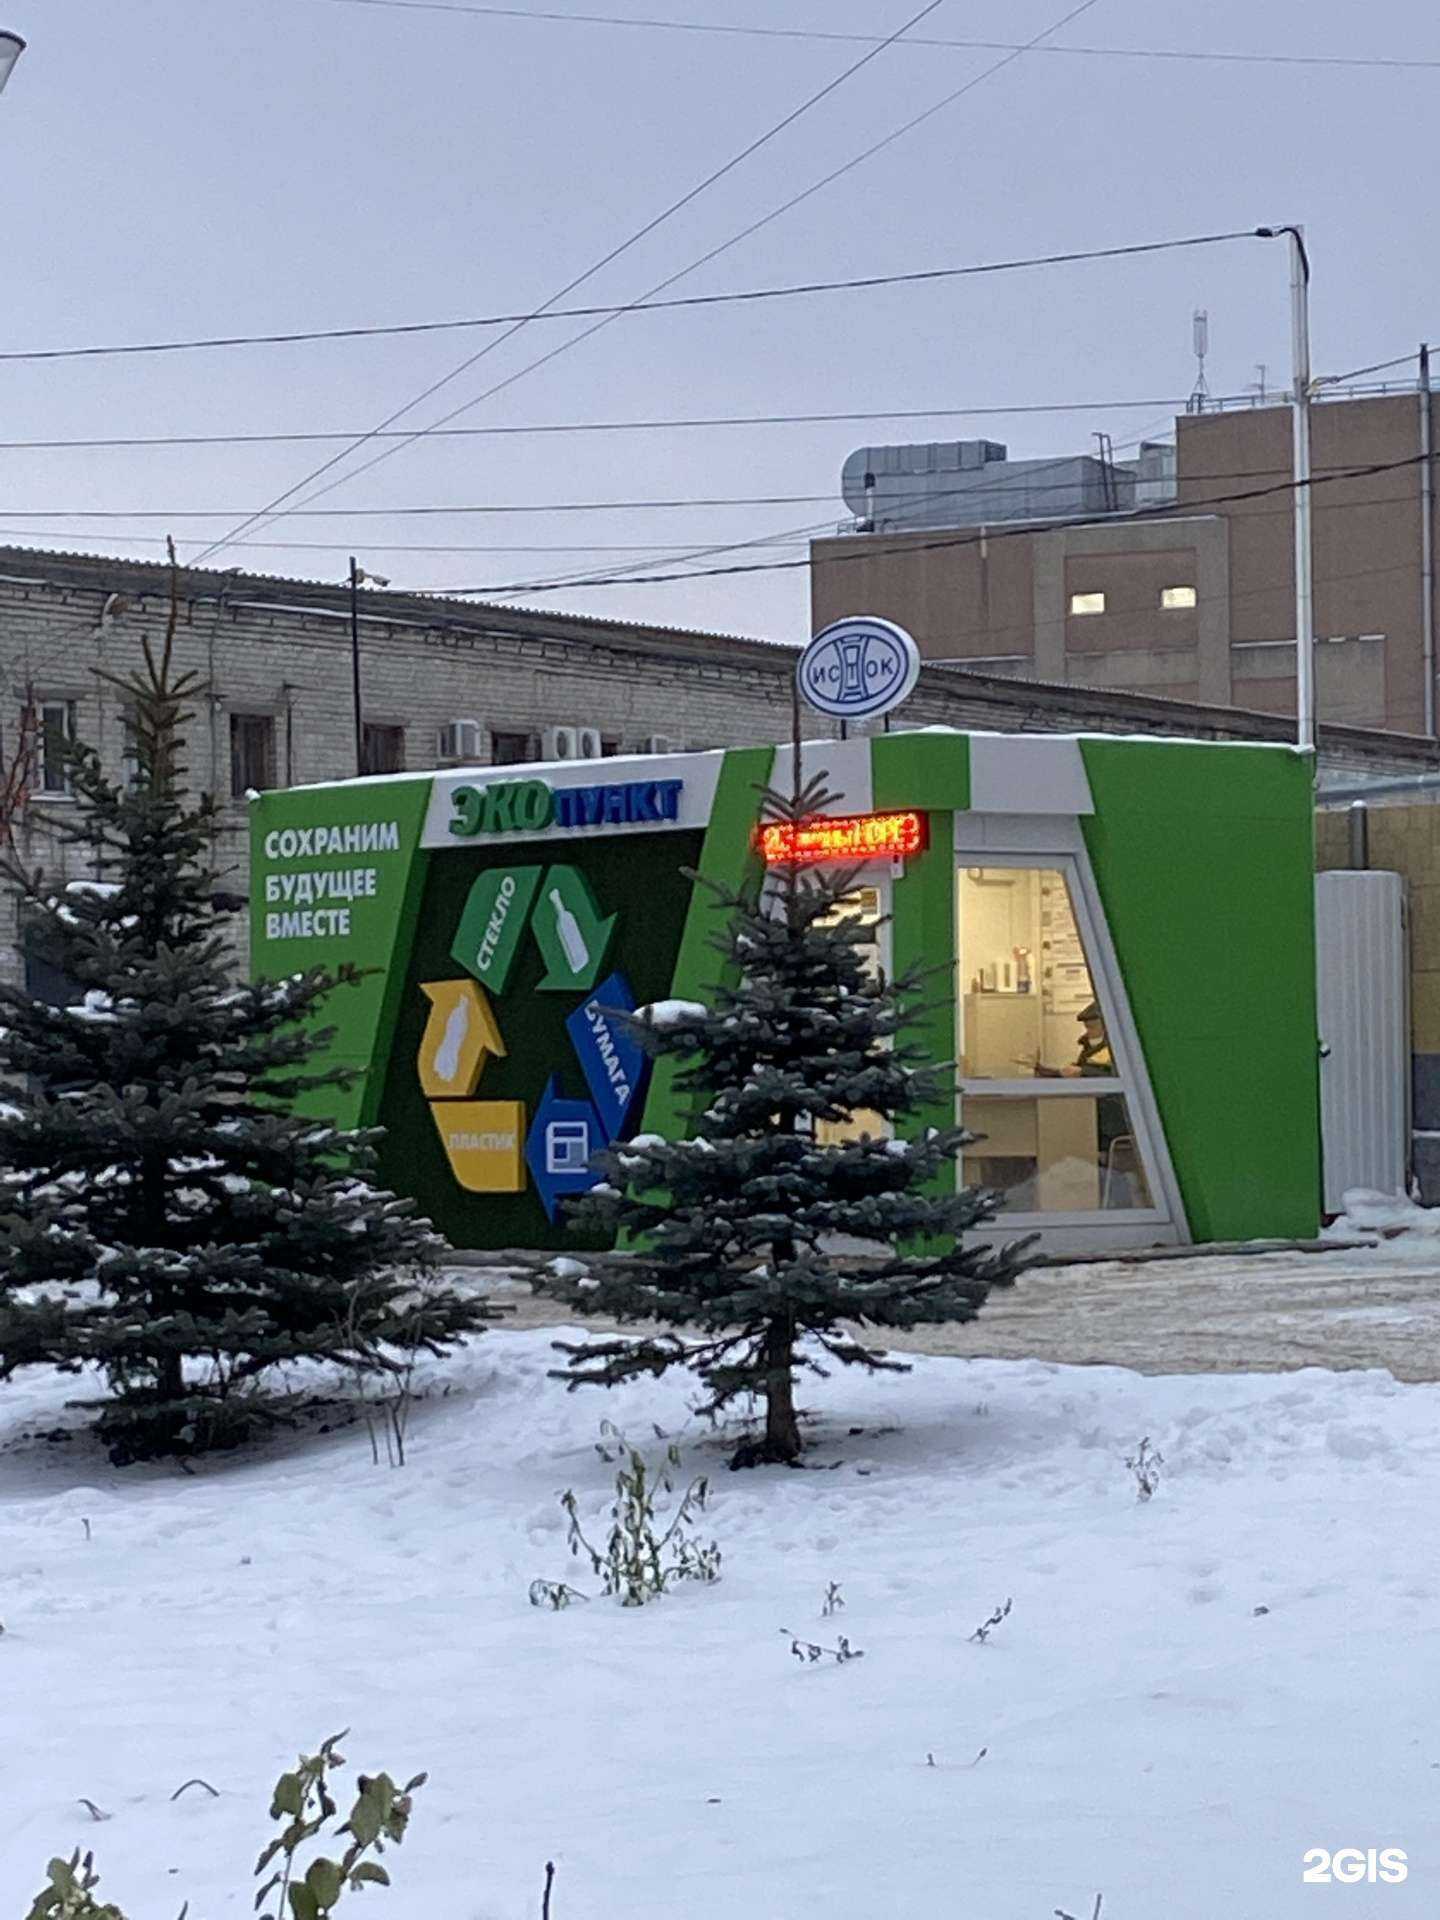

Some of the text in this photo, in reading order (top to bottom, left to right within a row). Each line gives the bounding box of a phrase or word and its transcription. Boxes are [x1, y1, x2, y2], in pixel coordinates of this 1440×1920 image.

[264, 821, 400, 860] СОХРАНИМ
[265, 867, 377, 905] БУДУЩЕЕ
[265, 908, 351, 940] ВМЕСТЕ
[476, 875, 516, 972] СТЕКЛО
